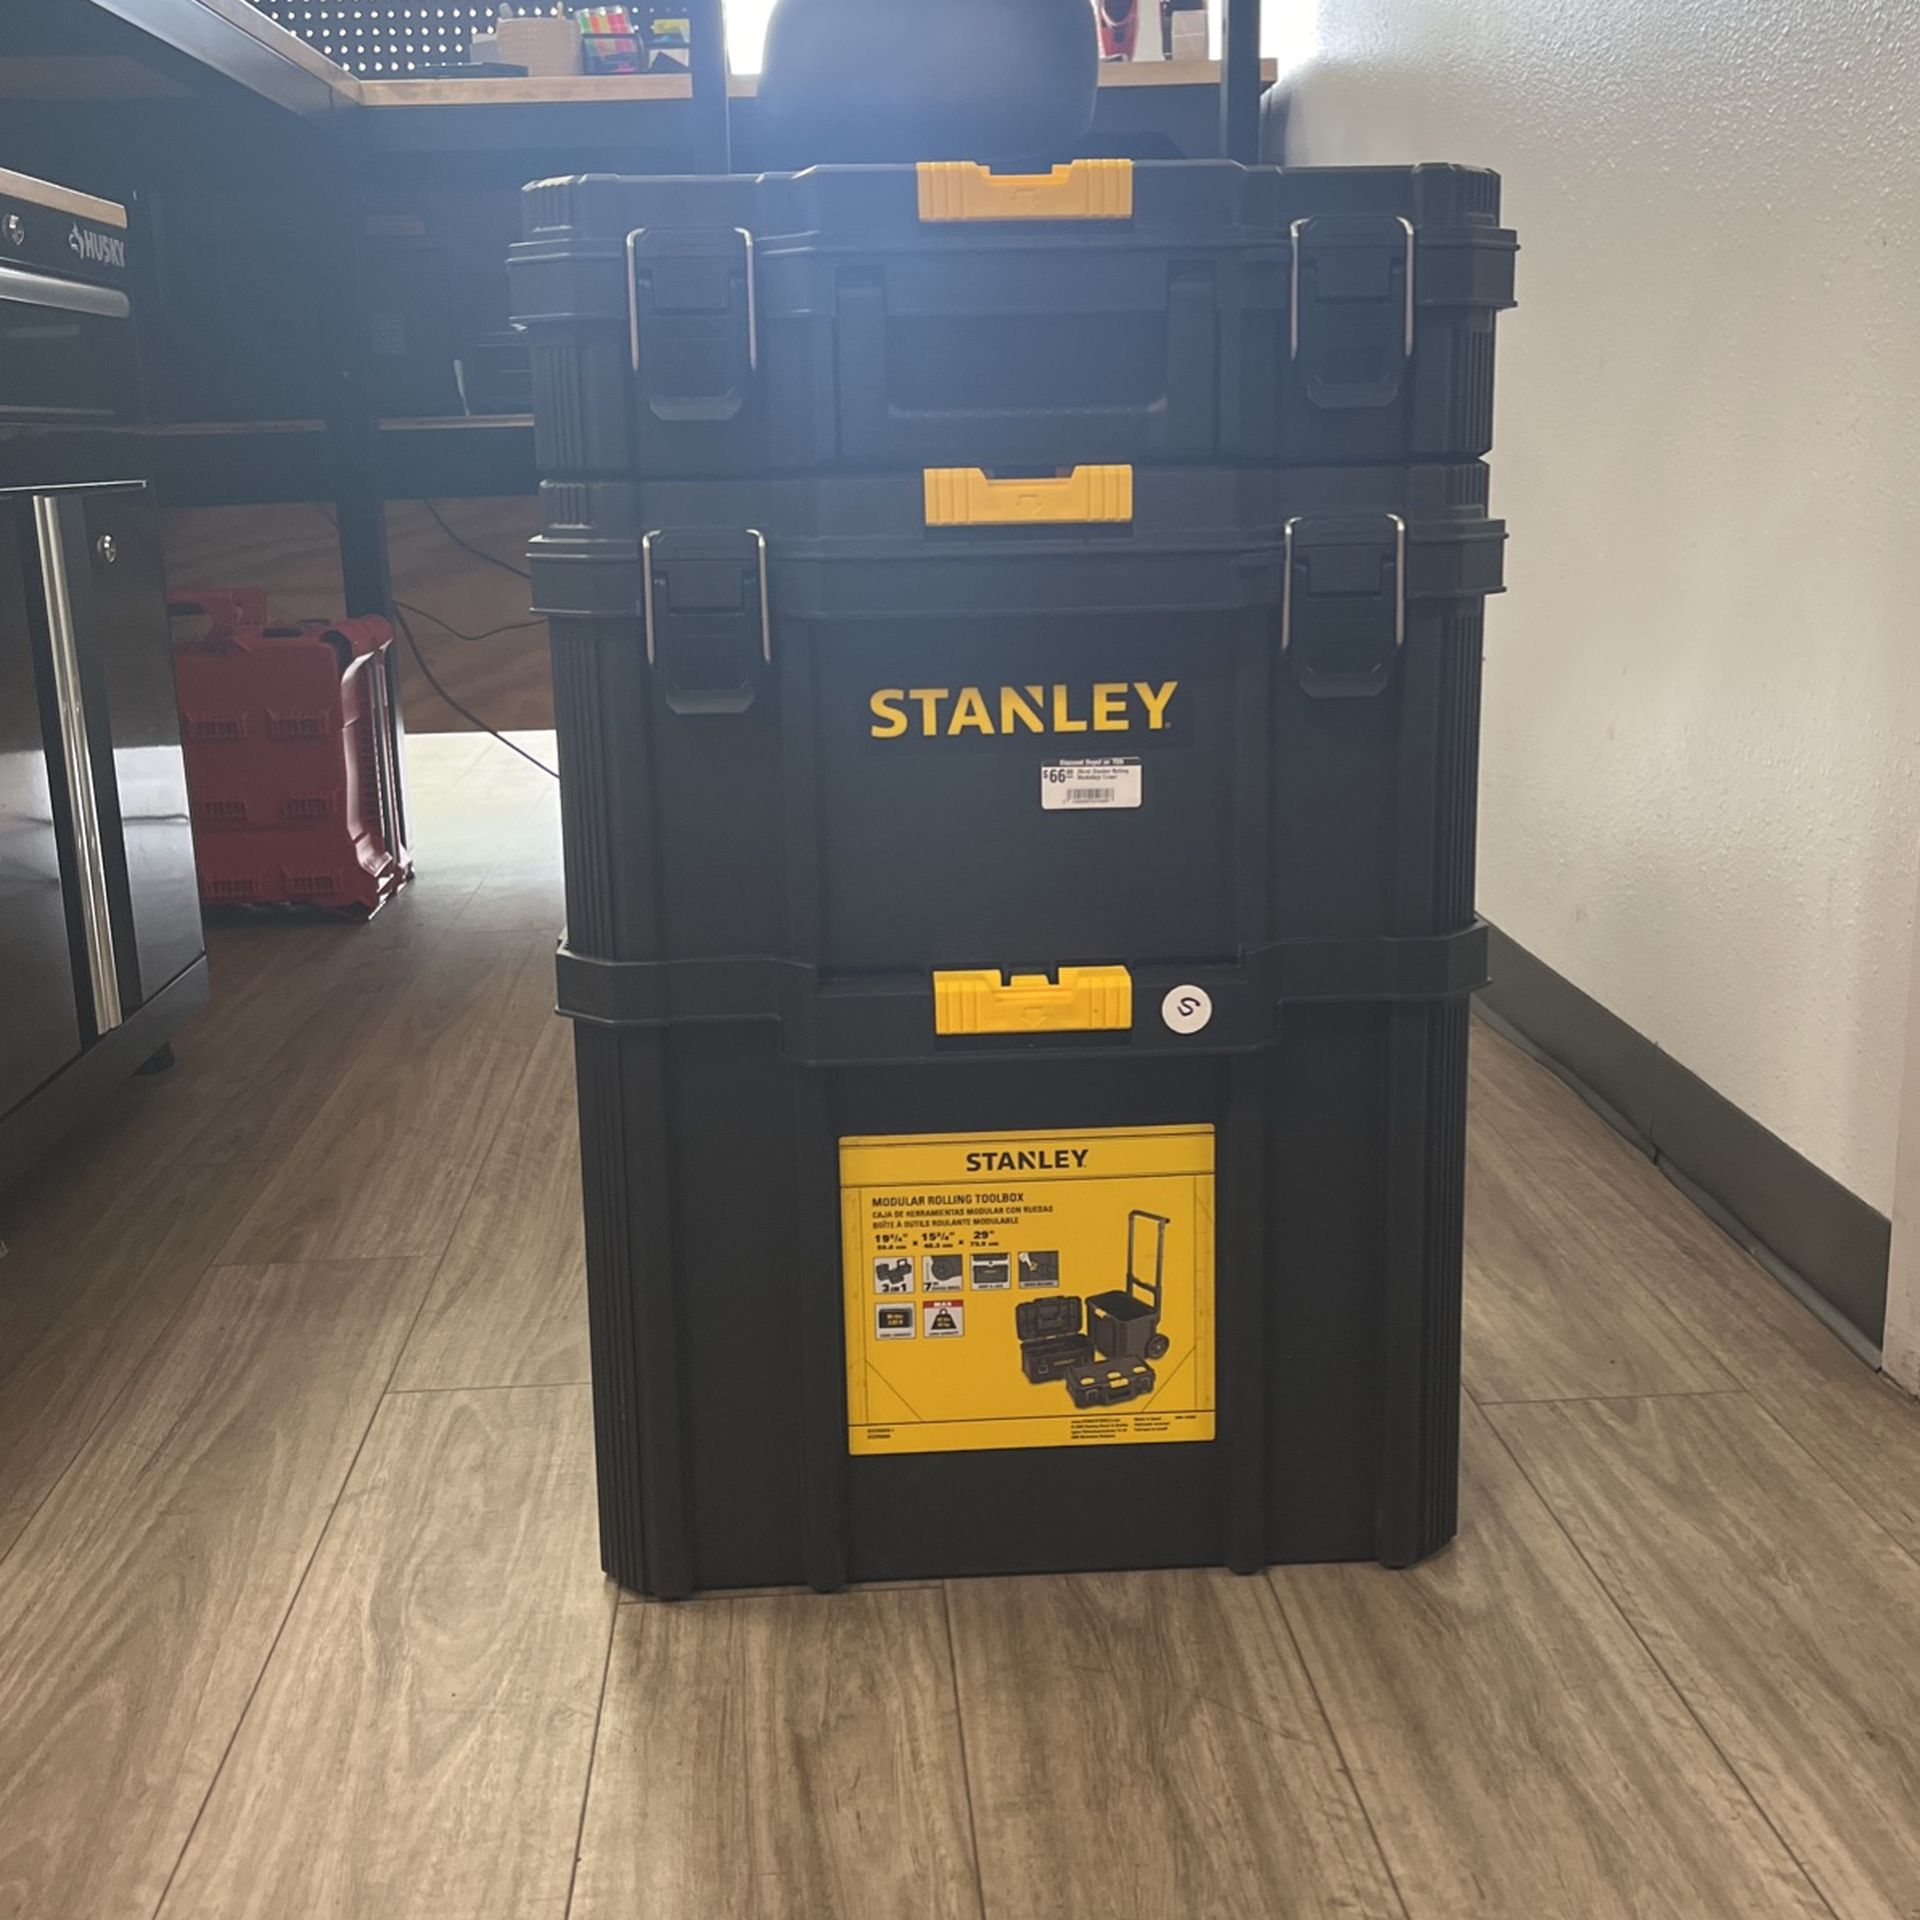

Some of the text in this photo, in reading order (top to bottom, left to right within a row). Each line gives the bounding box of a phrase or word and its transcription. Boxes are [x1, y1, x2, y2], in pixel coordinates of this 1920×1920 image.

[84, 229, 125, 268] HUSKY
[870, 681, 1178, 738] STANLEY
[966, 1149, 1089, 1172] STANLEY
[872, 1192, 1025, 1207] MODULAR ROLLING TOOLBOX
[872, 1210, 893, 1219] CAJA
[966, 1206, 1004, 1216] MODULAR
[1005, 1206, 1022, 1215] CON
